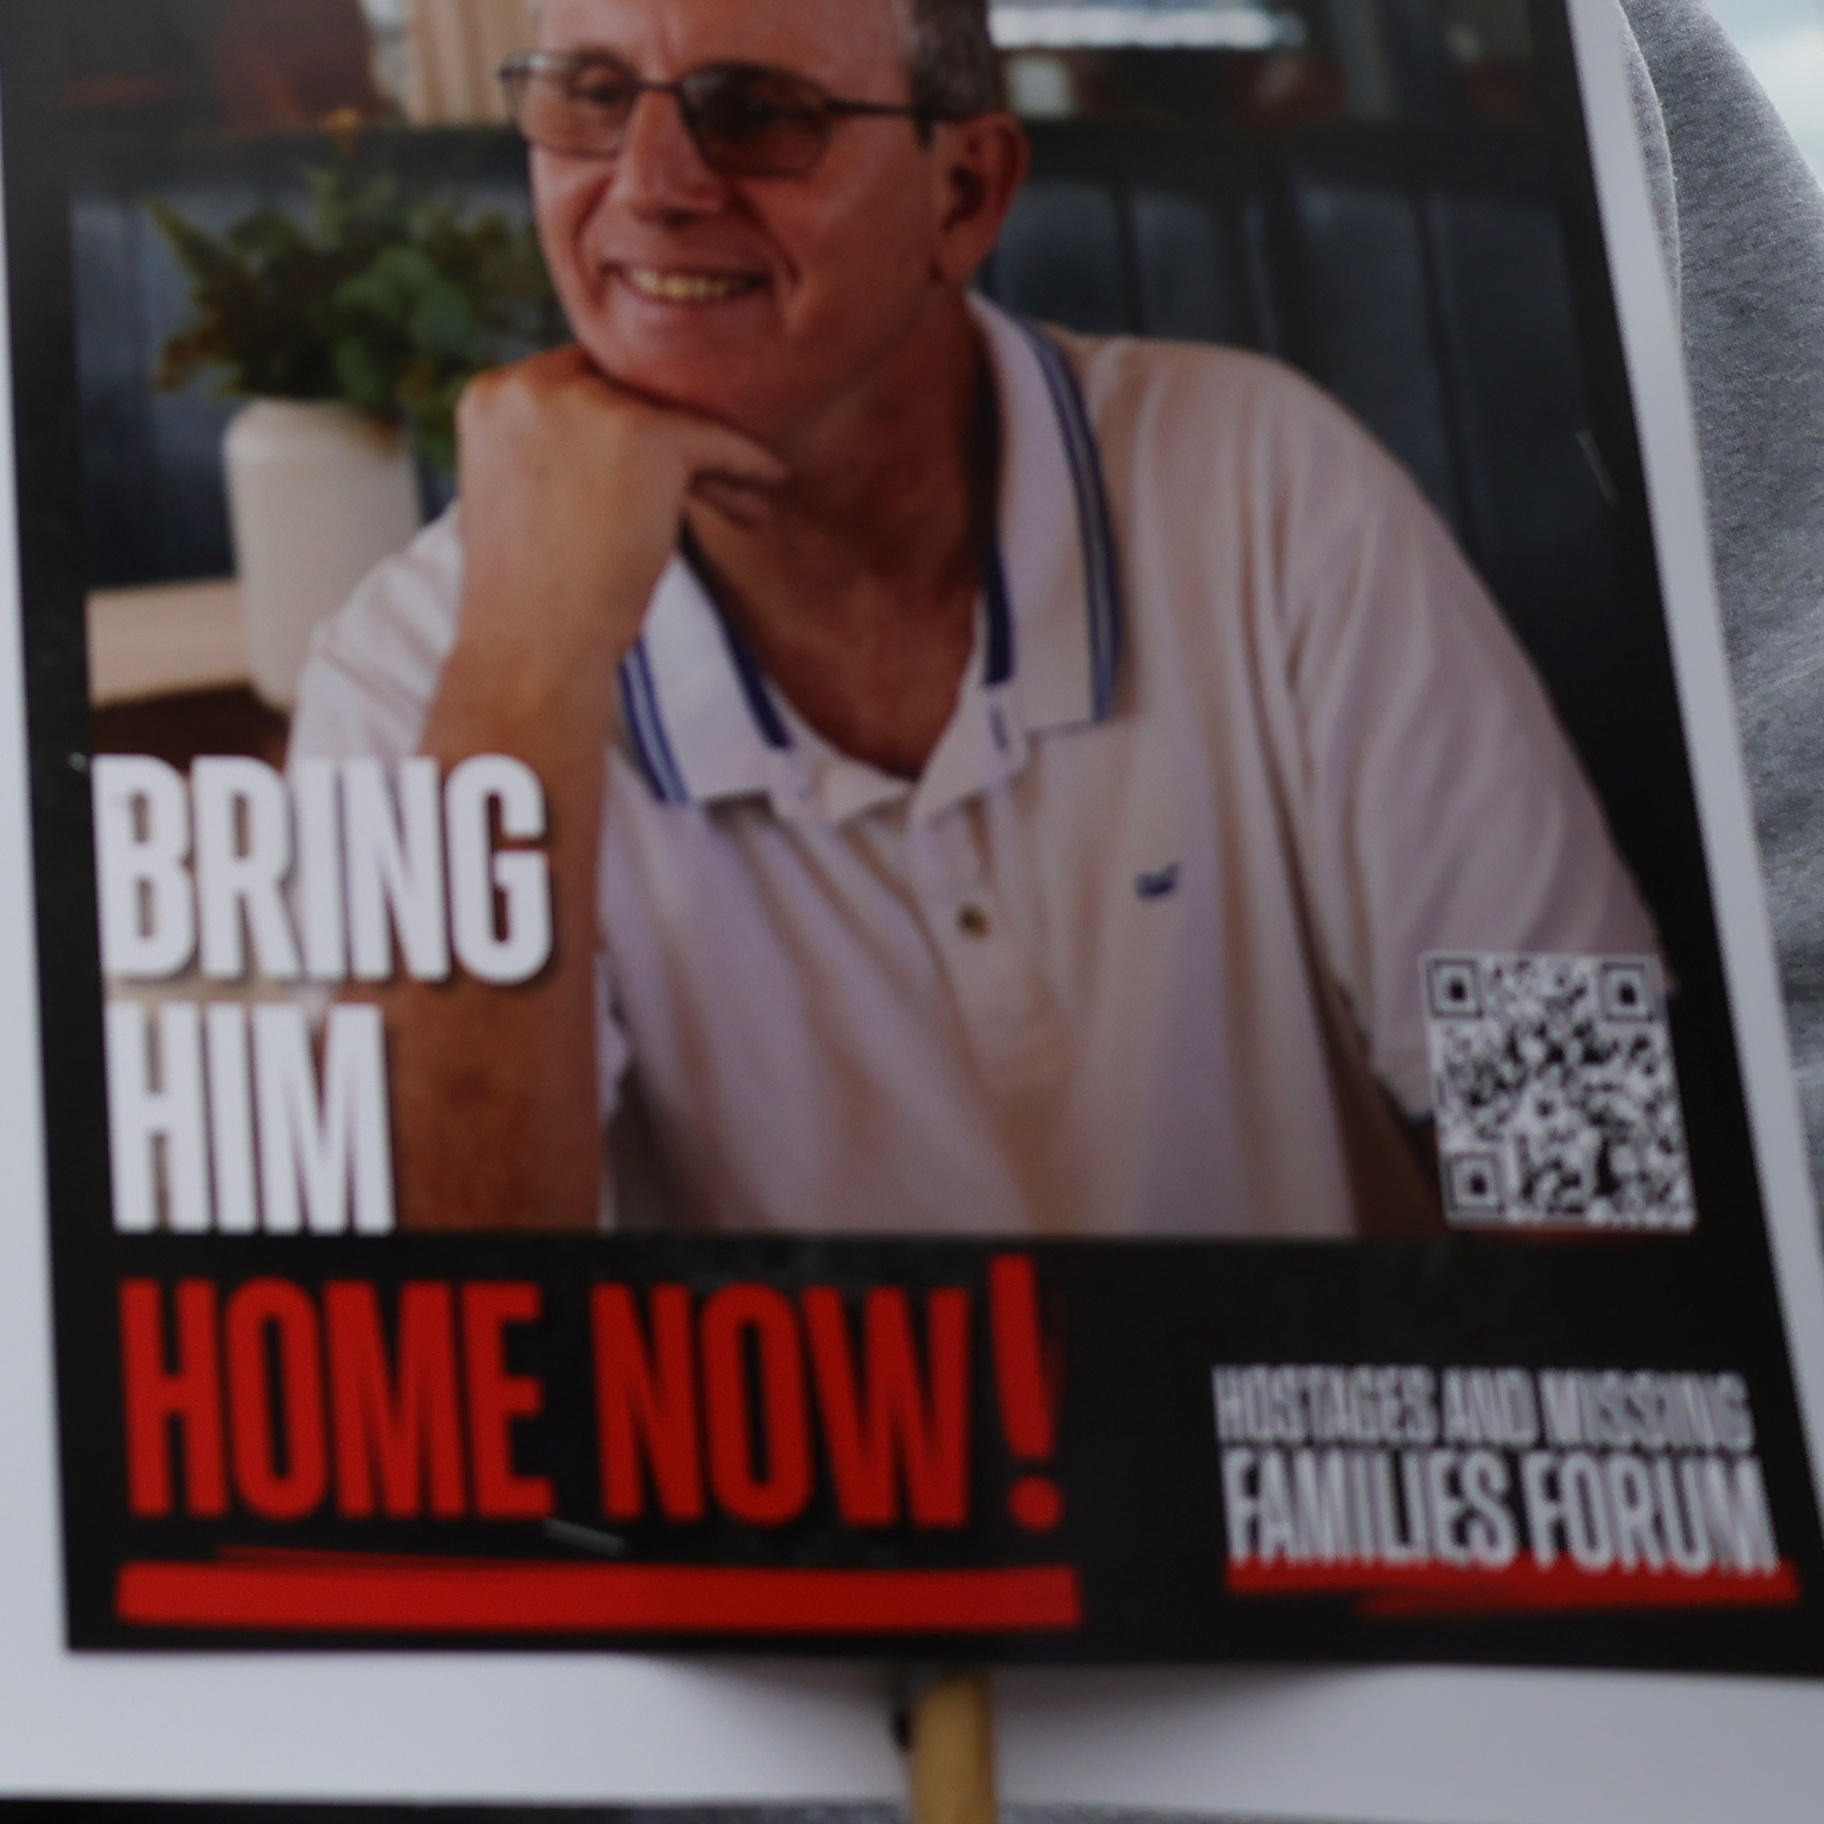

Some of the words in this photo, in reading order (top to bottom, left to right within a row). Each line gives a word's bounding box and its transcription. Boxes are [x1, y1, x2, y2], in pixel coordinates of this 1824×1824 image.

[90, 752, 554, 984] BRING
[104, 1001, 397, 1235] HIM
[118, 1276, 552, 1521] HOME
[589, 1253, 1064, 1531] NOW!
[1211, 1364, 1439, 1446] HOSTAGES
[1442, 1366, 1538, 1448] AND
[1539, 1367, 1757, 1452] MISSING
[1220, 1447, 1519, 1570] FAMILIES
[1520, 1450, 1782, 1578] FORUM
